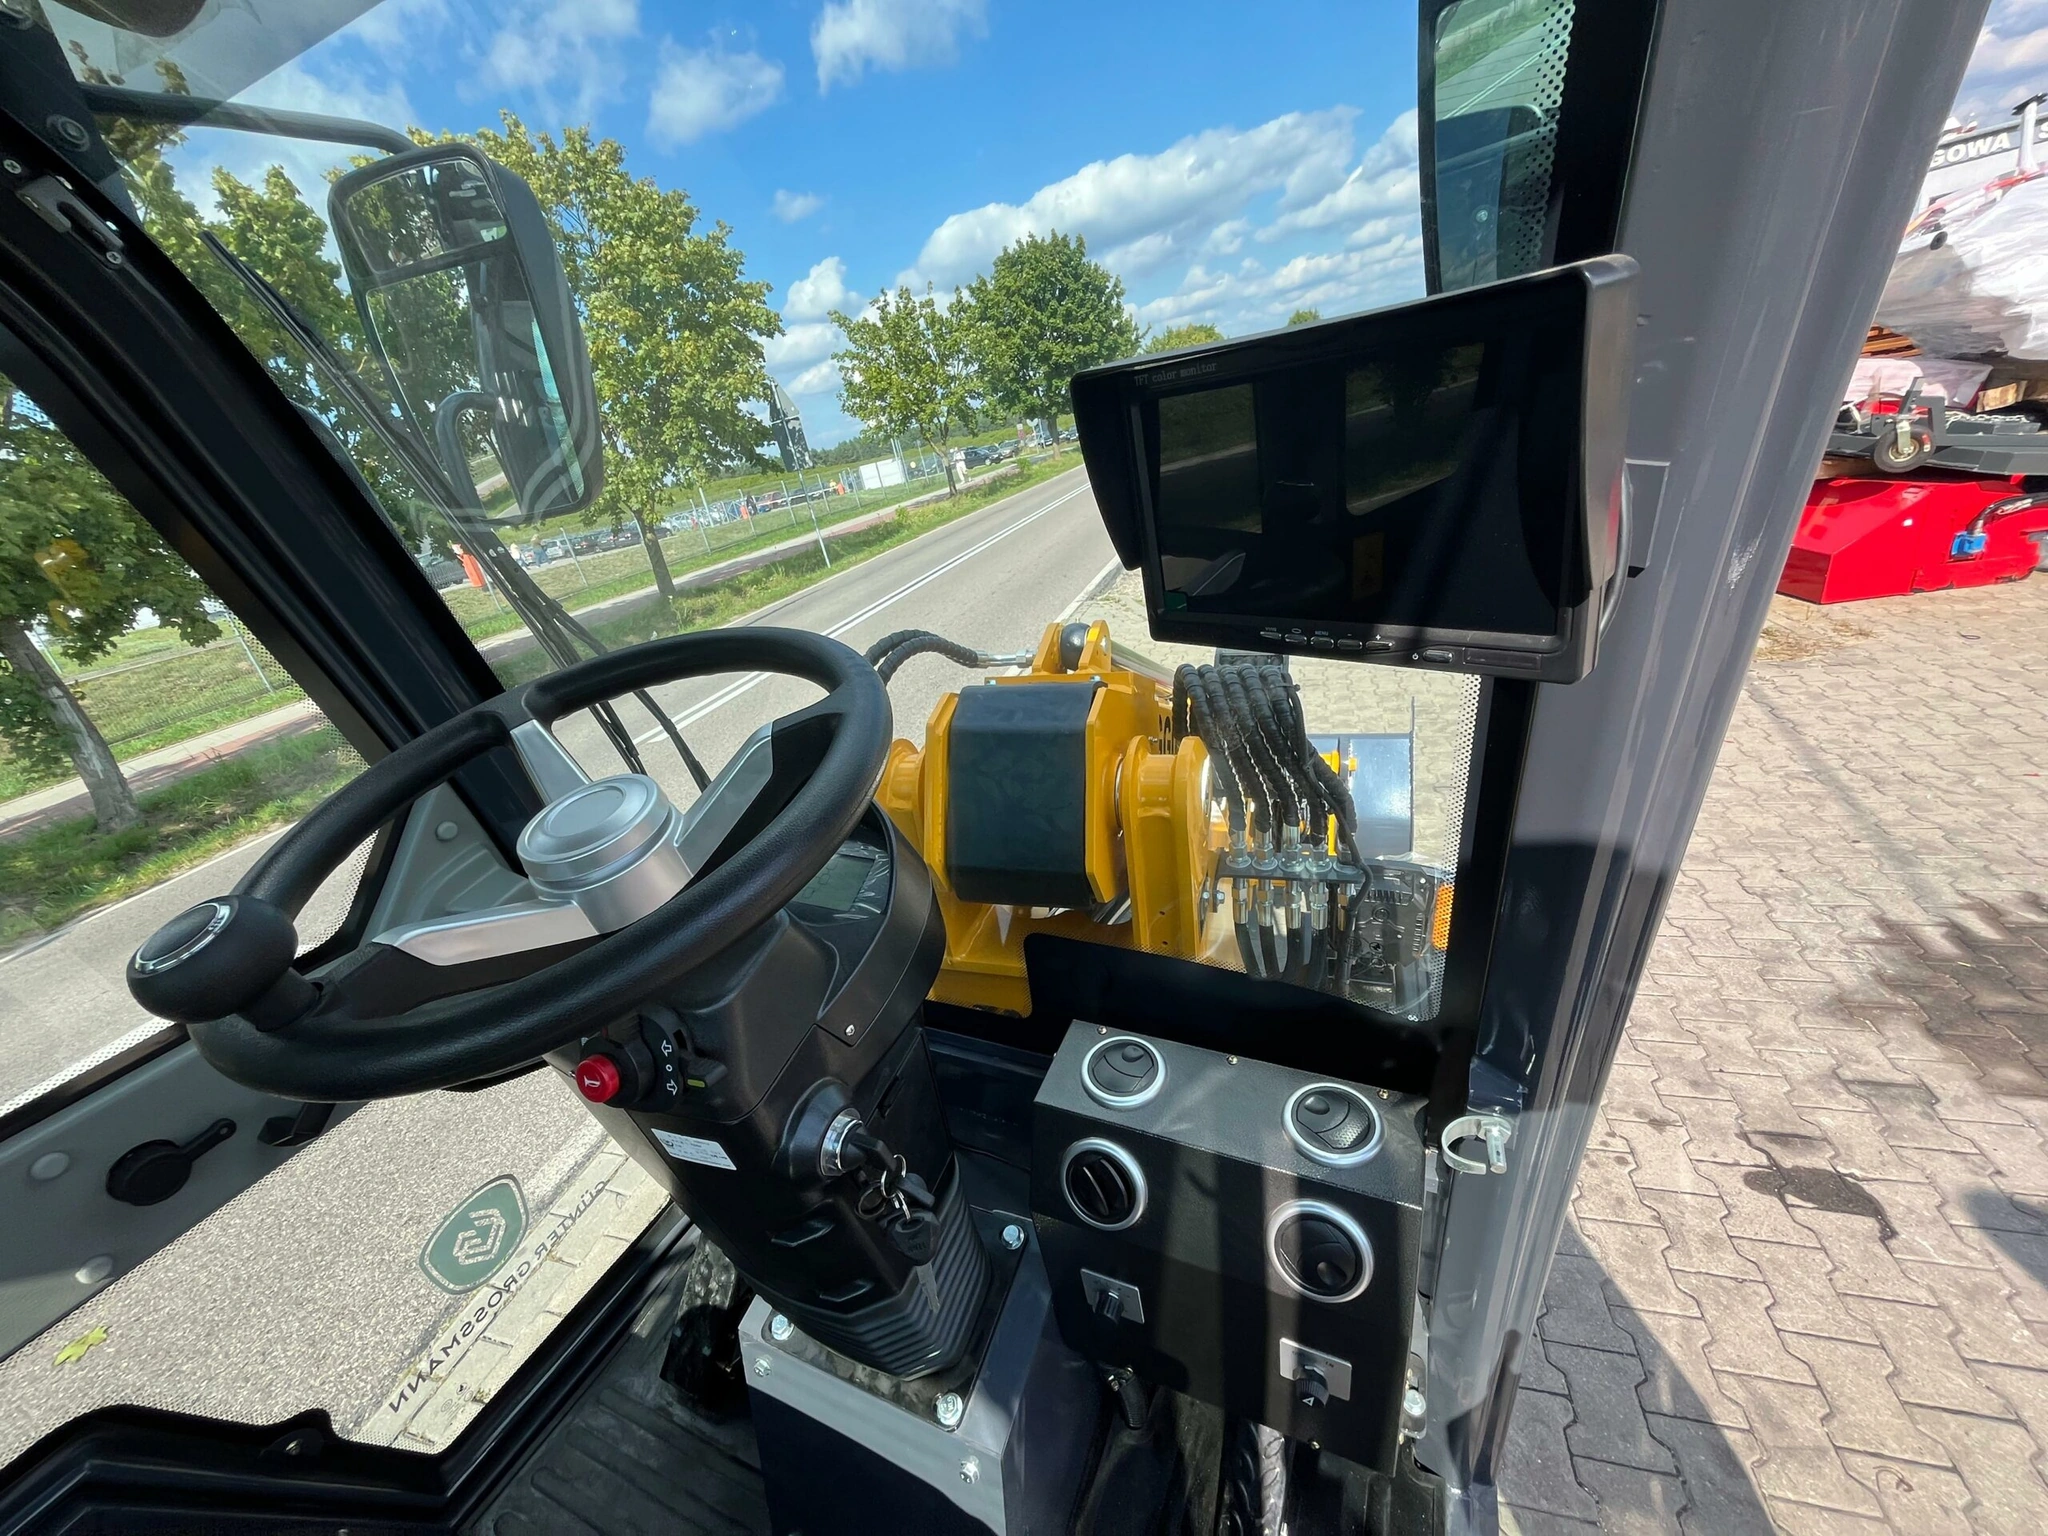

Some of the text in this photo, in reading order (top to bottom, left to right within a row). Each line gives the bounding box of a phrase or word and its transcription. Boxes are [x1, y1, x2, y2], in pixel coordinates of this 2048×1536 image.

[1134, 362, 1217, 386] TFT color monitor
